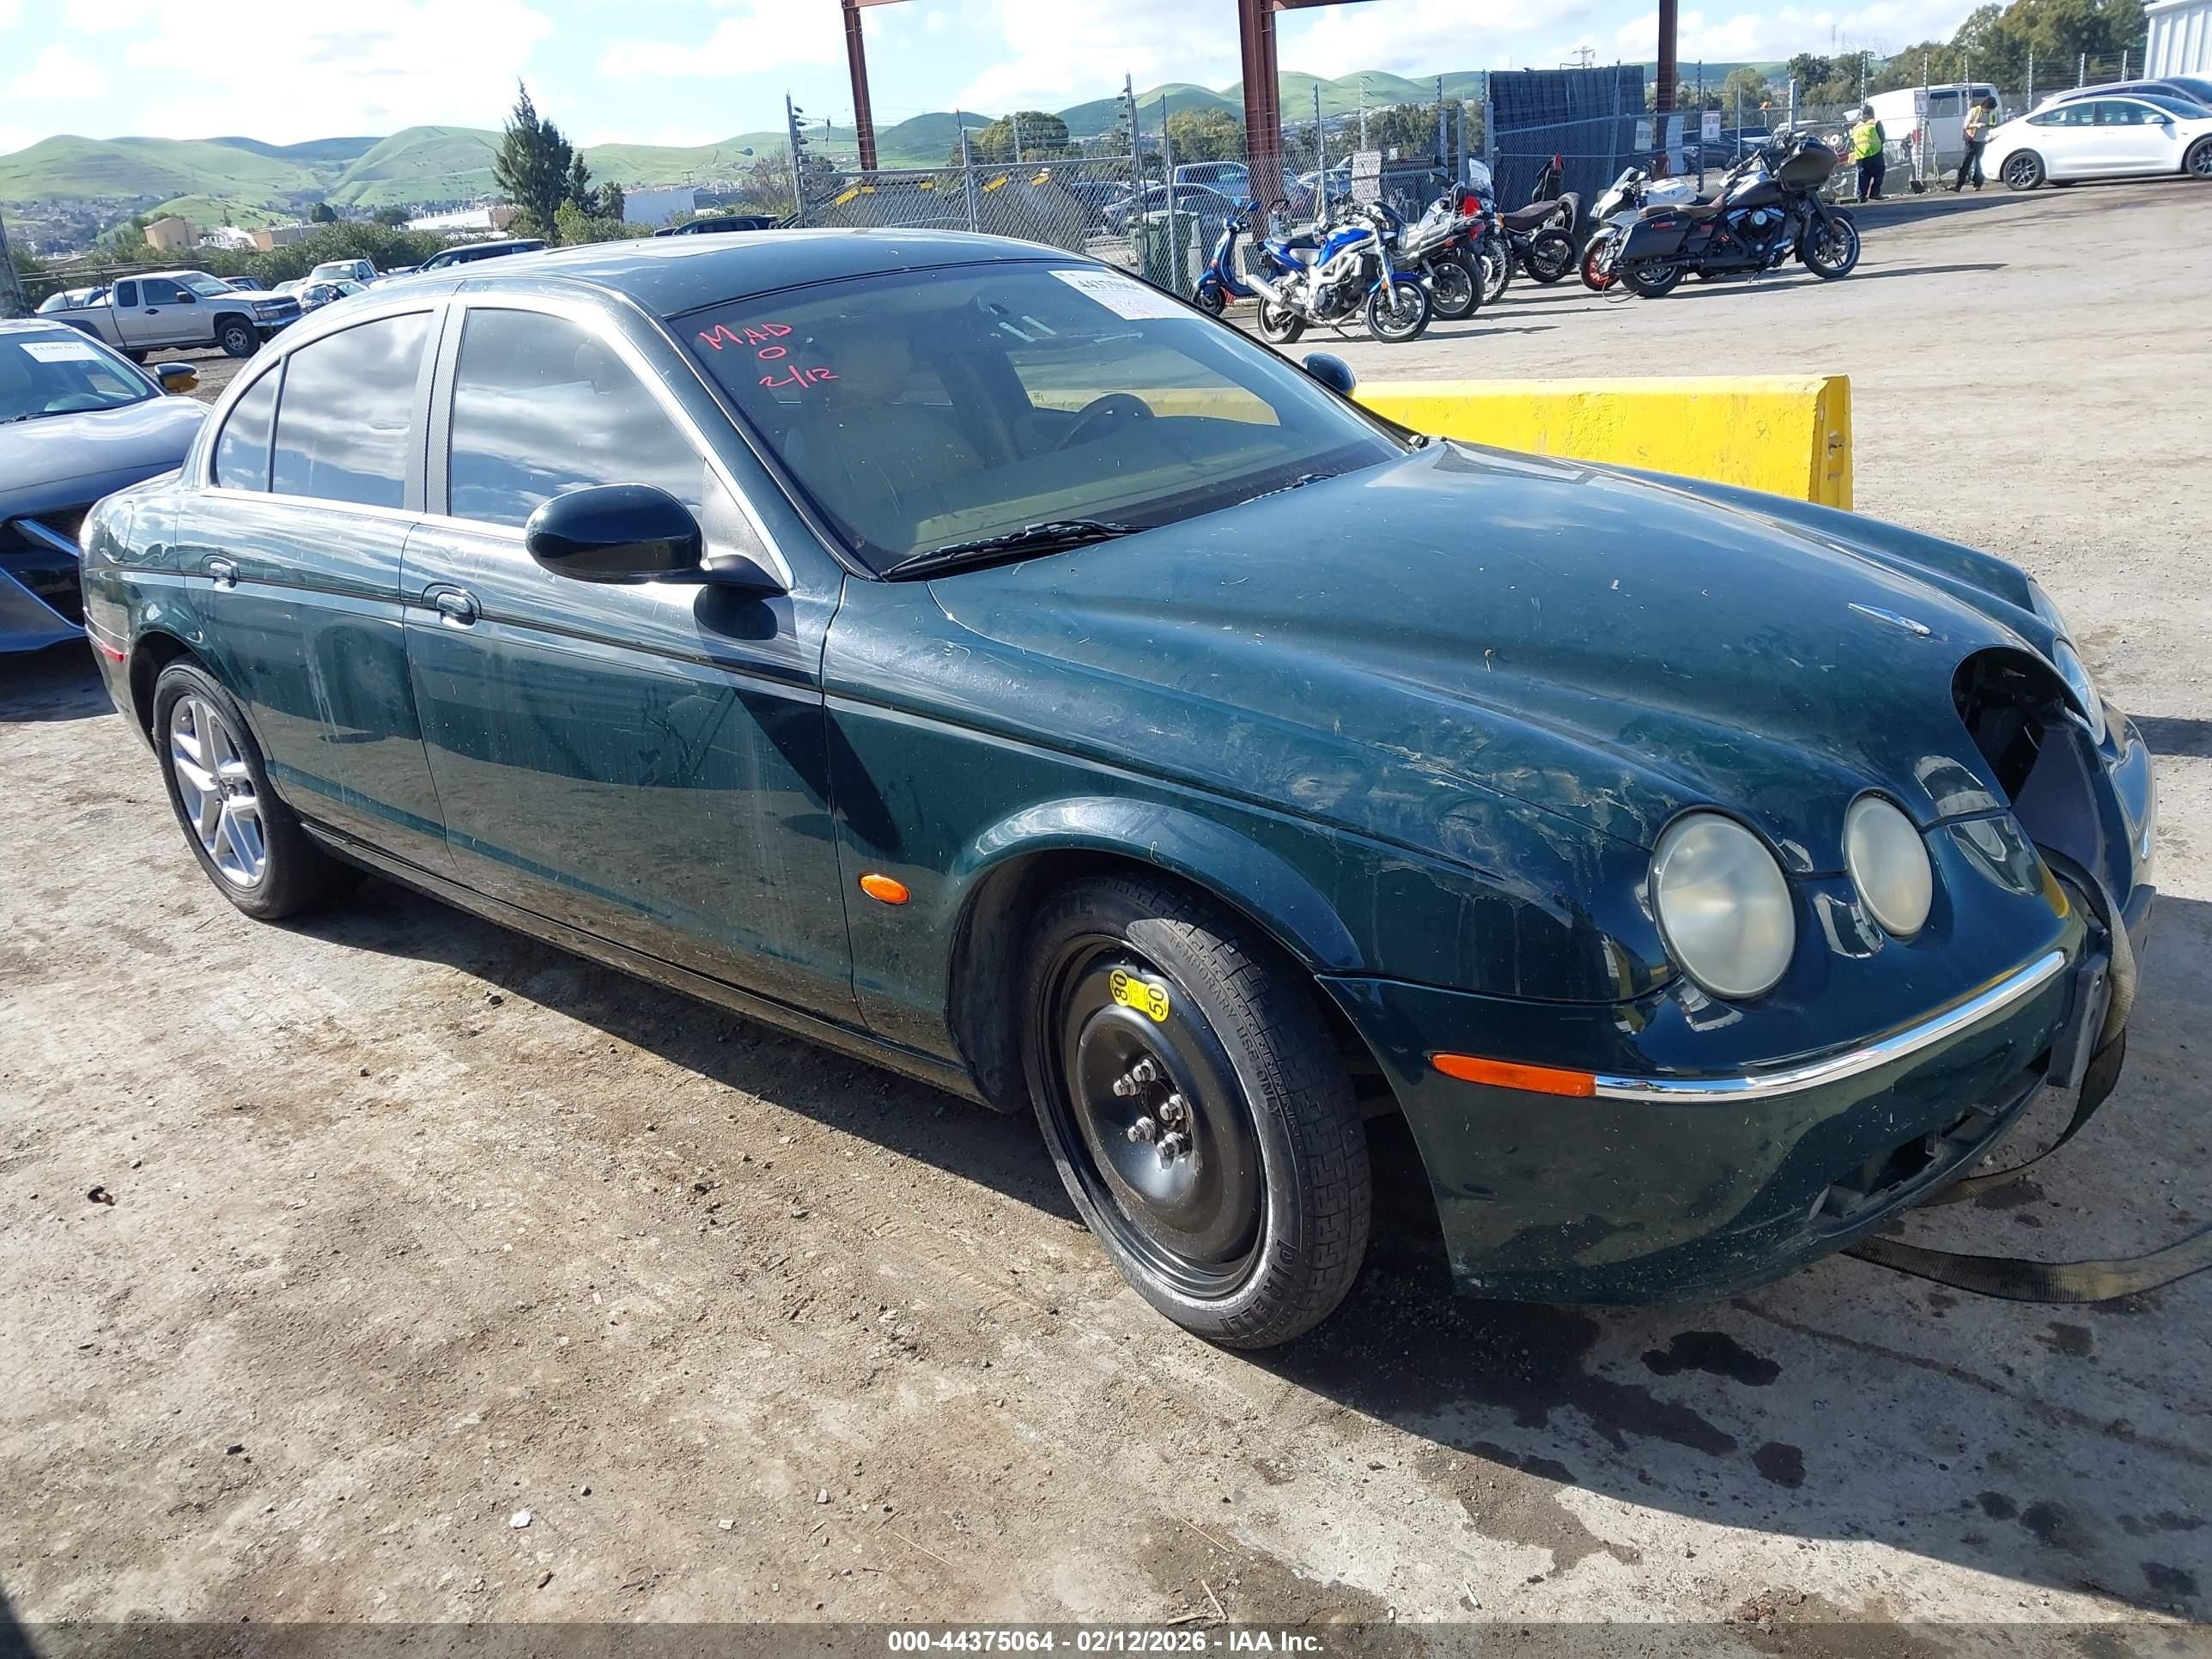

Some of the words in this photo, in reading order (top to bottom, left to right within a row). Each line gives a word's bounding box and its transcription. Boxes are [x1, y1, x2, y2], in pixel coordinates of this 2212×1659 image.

[758, 365, 840, 389] 2/12
[1113, 973, 1128, 1002] 80
[1147, 987, 1165, 1018] 50
[1236, 1025, 1261, 1063] USE
[1256, 1069, 1282, 1116] ONLY
[1218, 1237, 1298, 1336] PIRELLI
